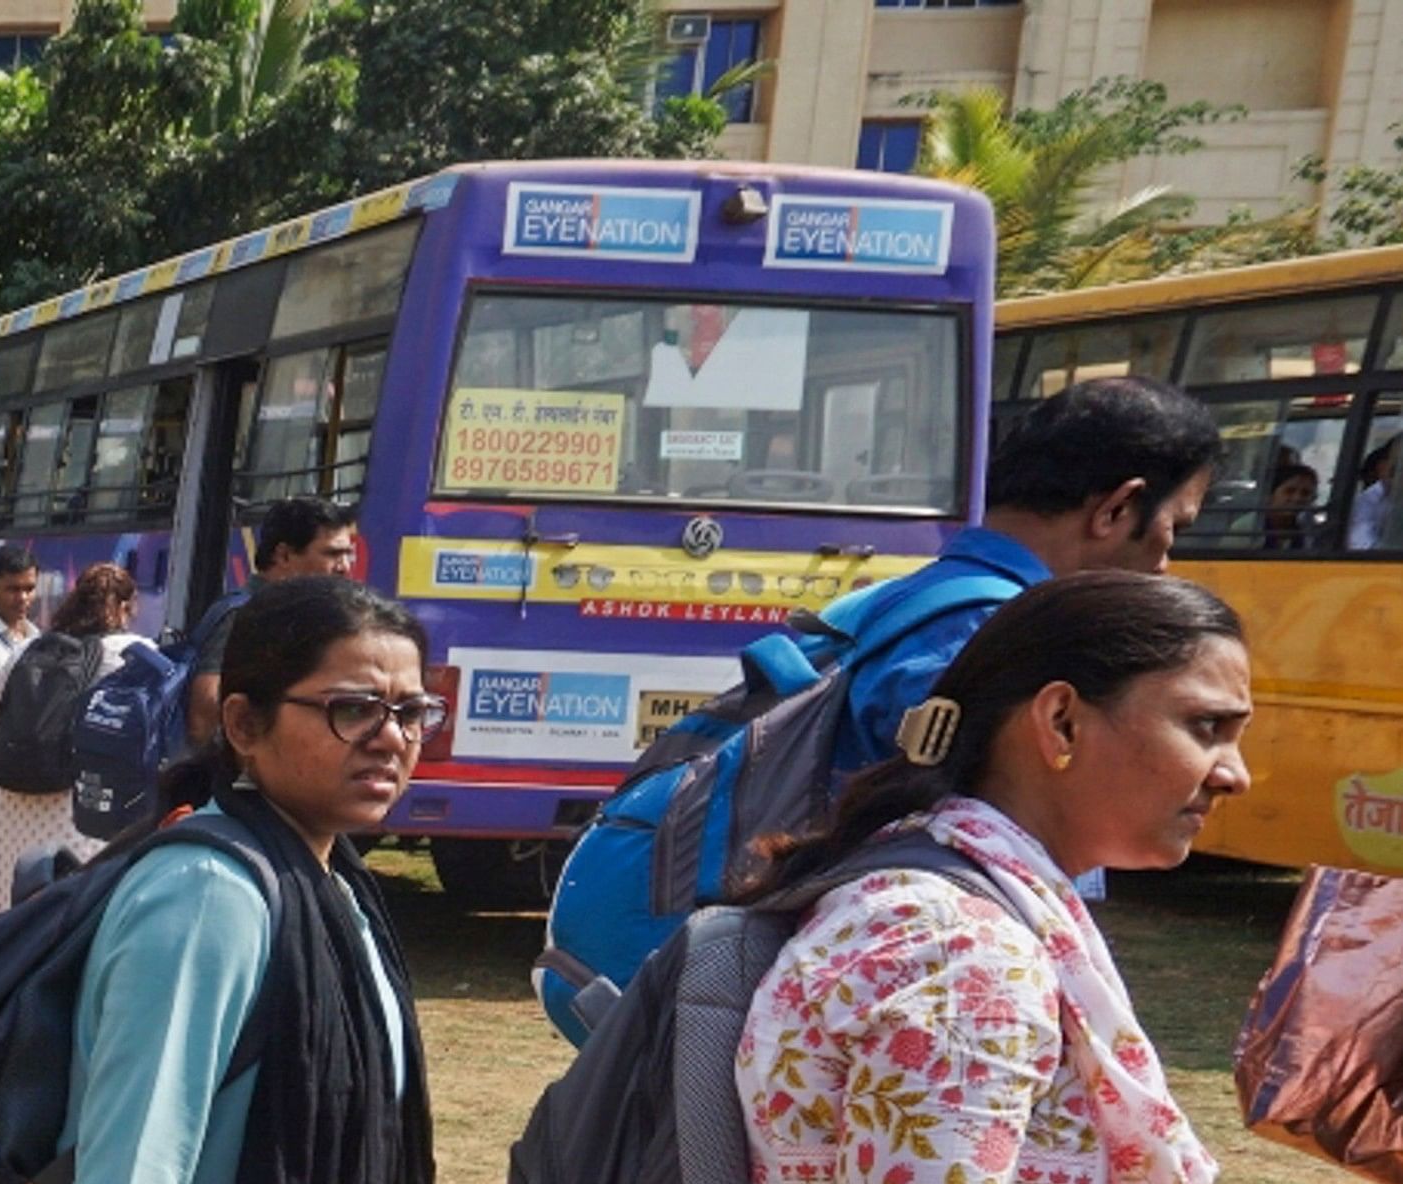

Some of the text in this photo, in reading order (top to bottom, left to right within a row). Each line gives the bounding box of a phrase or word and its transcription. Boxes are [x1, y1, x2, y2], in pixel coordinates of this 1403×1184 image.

[525, 199, 592, 215] GANGAR
[786, 211, 849, 227] GANGAR
[522, 215, 681, 245] EYENATION
[783, 227, 934, 257] EYENATION
[457, 428, 617, 457] 1800229901
[452, 456, 614, 485] 8976589671
[583, 601, 675, 618] ASHOK
[687, 606, 792, 622] LEYLAN
[473, 691, 623, 718] EYENATION
